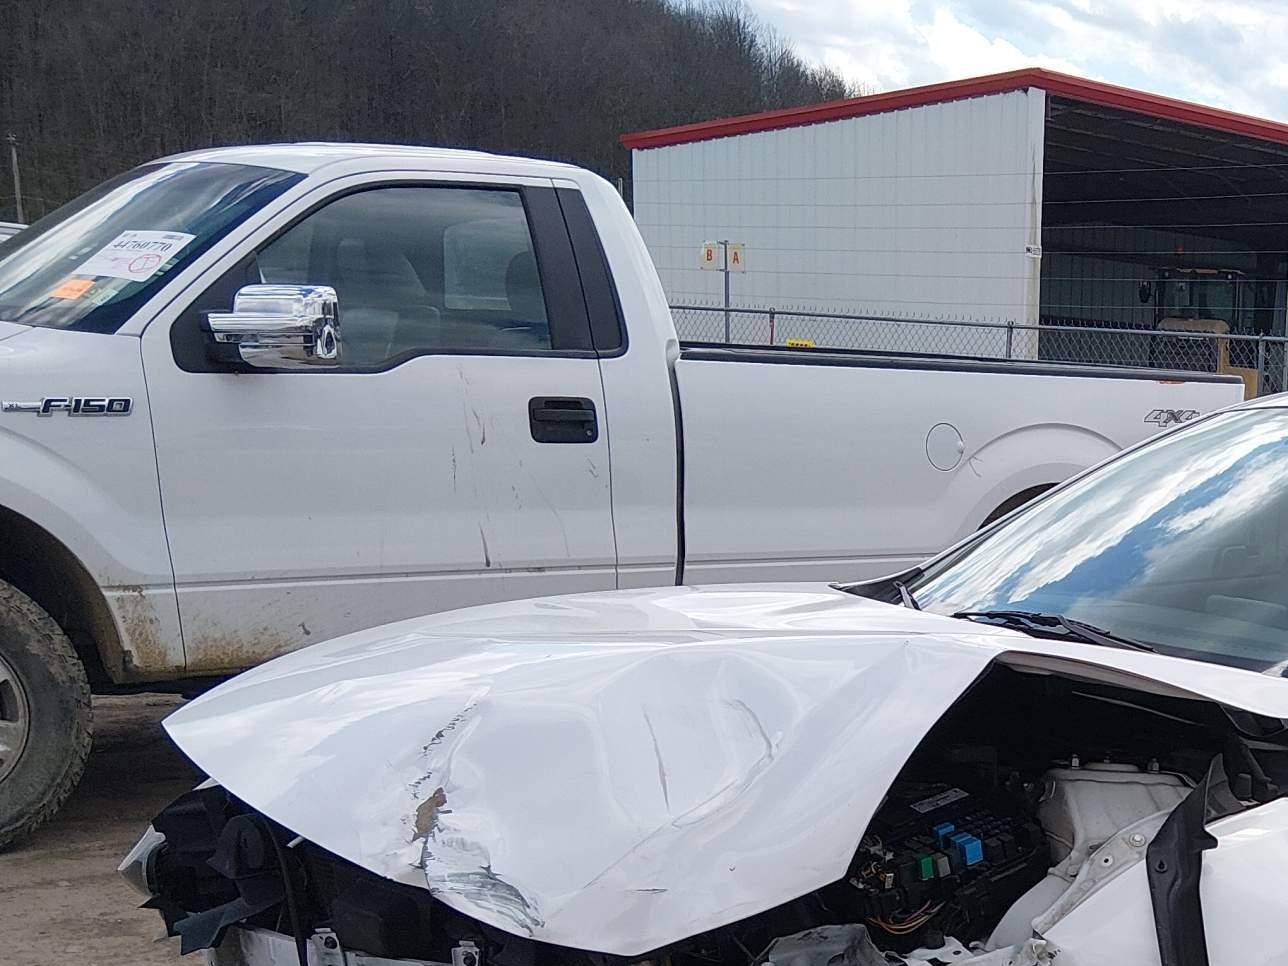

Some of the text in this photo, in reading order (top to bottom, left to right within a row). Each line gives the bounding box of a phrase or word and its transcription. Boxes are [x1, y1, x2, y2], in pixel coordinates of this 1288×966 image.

[706, 249, 713, 261] B
[732, 251, 740, 264] A
[40, 398, 133, 416] F-150
